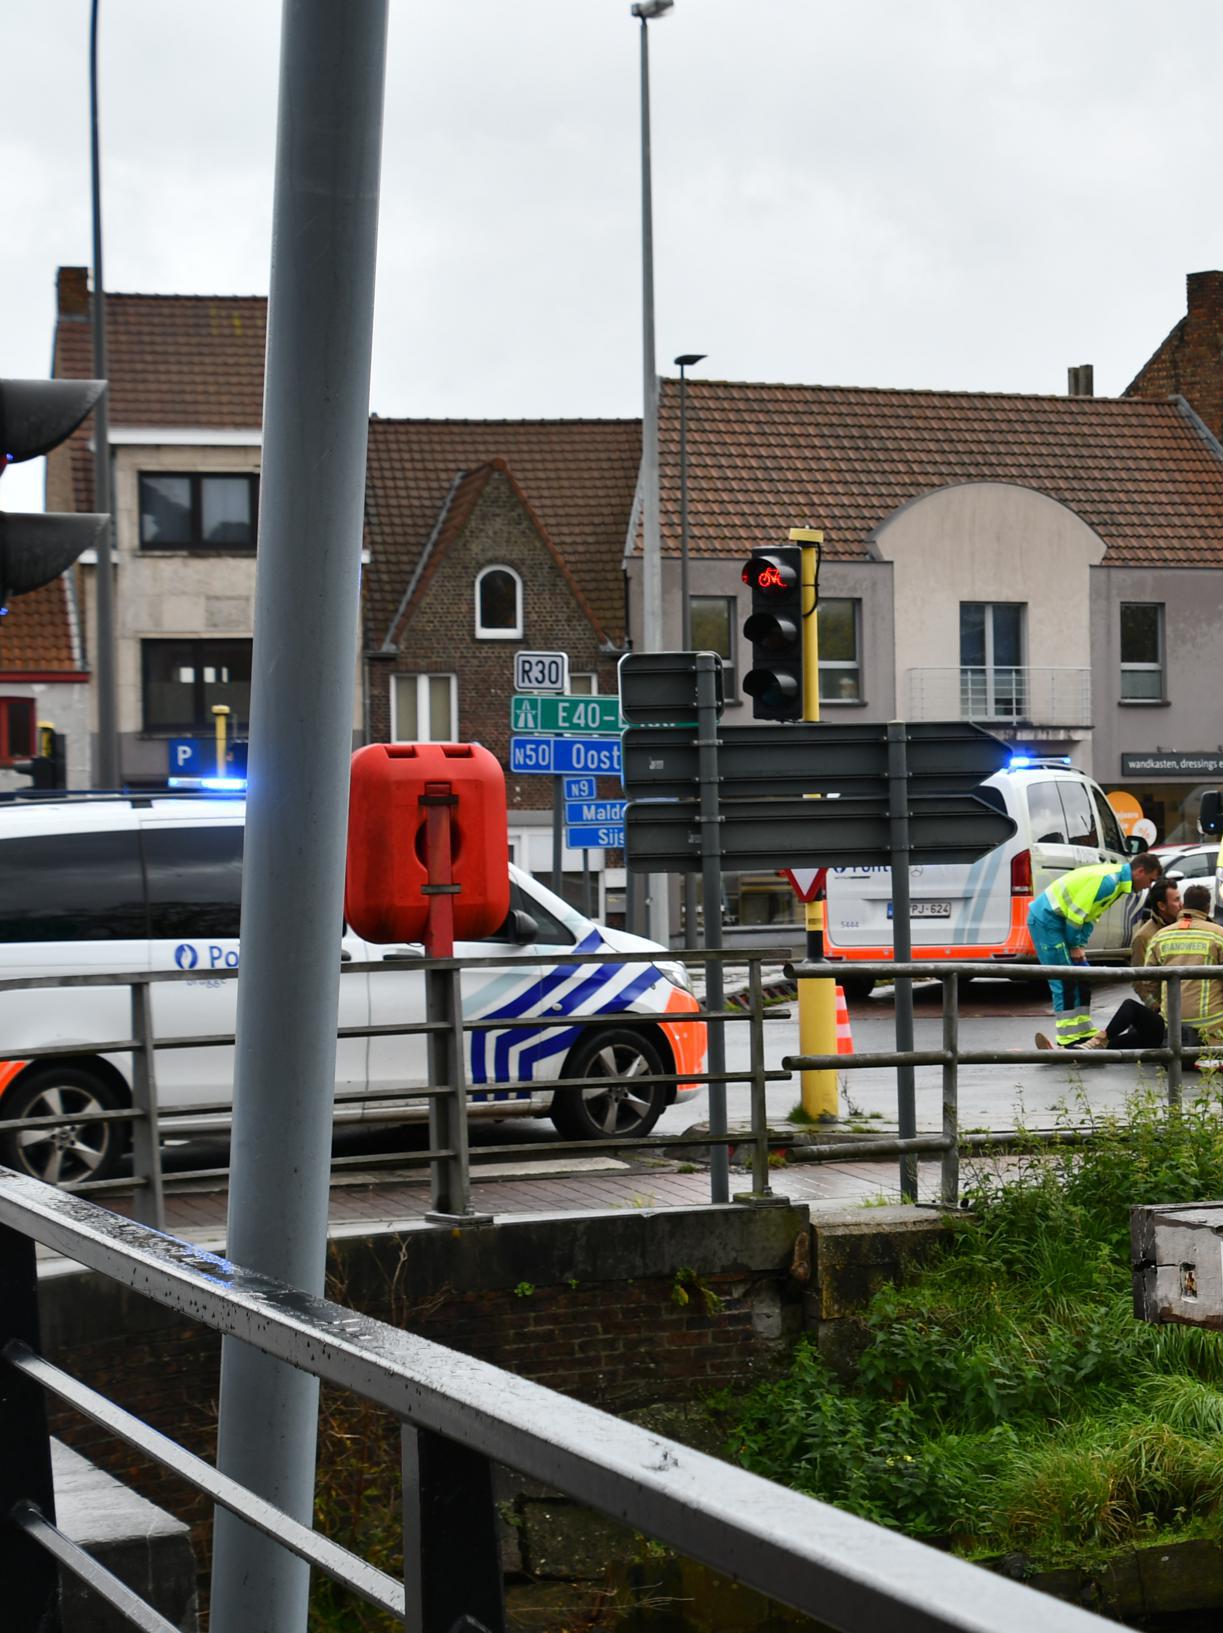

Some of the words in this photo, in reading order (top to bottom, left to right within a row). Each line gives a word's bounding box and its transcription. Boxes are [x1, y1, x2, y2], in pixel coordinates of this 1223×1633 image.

[521, 660, 559, 684] R30
[177, 746, 192, 766] P
[515, 743, 549, 766] N50
[572, 743, 621, 770] Oost
[1128, 759, 1179, 769] wandkasten,
[1180, 759, 1217, 770] dressings
[571, 780, 588, 796] N9
